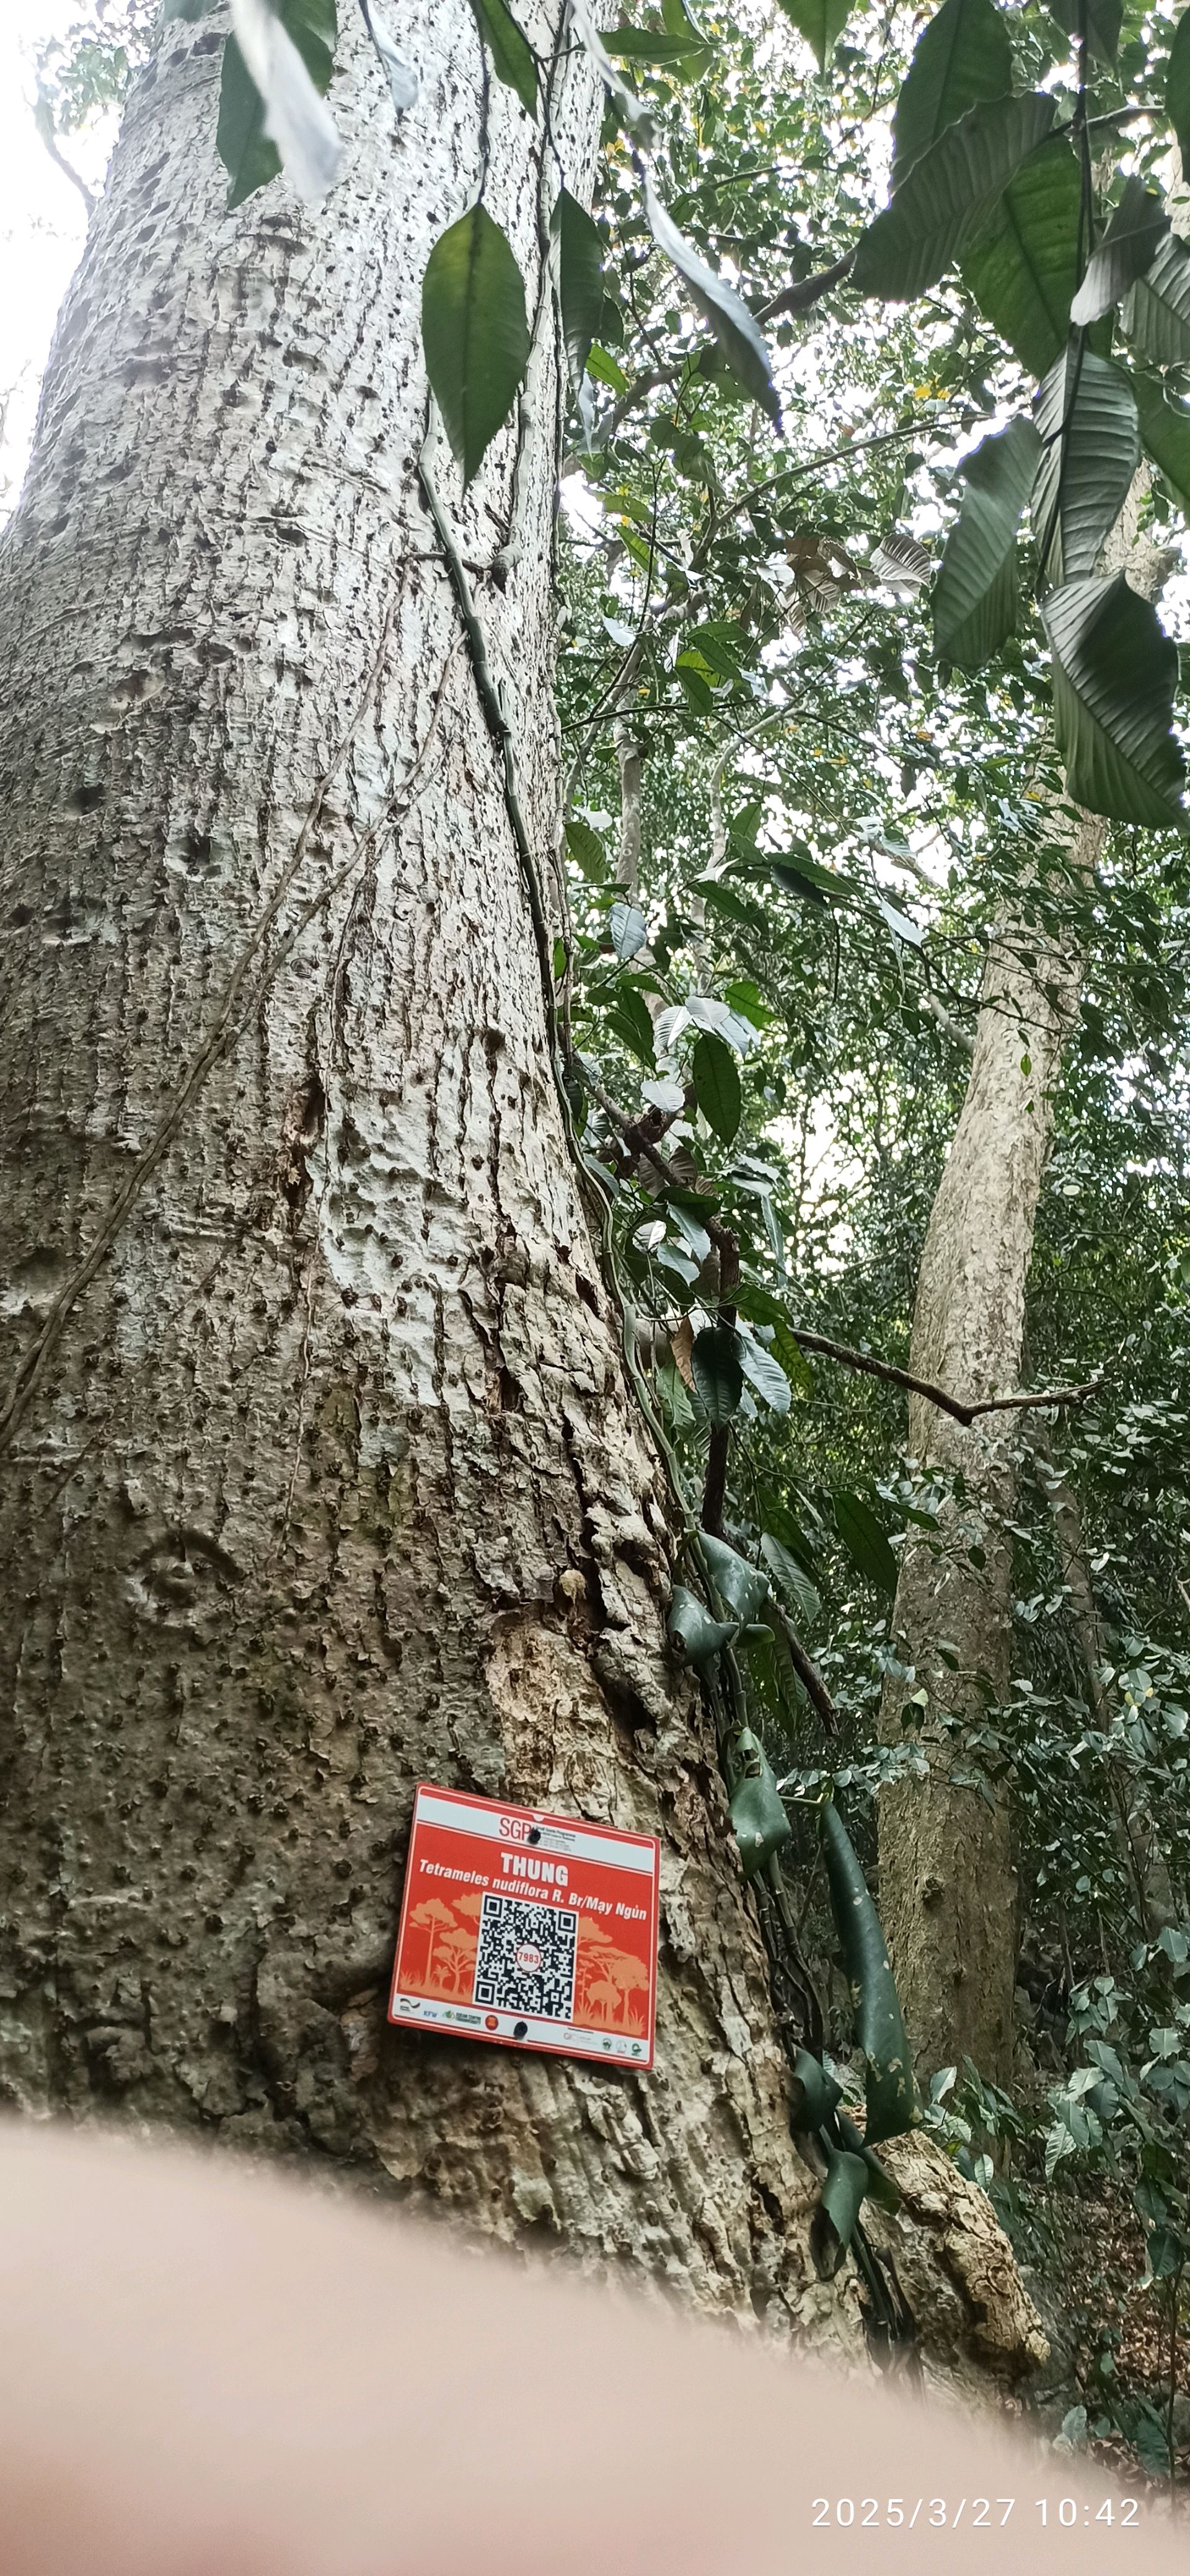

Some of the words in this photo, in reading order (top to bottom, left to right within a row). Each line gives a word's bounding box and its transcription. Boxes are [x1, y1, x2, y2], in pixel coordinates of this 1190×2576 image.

[499, 1817, 532, 1841] SGP
[419, 1859, 490, 1886] Tetrameles
[492, 1878, 549, 1900] nudiflora
[552, 1889, 565, 1903] R.
[501, 1852, 568, 1887] THUNG
[519, 1952, 539, 1964] 7983
